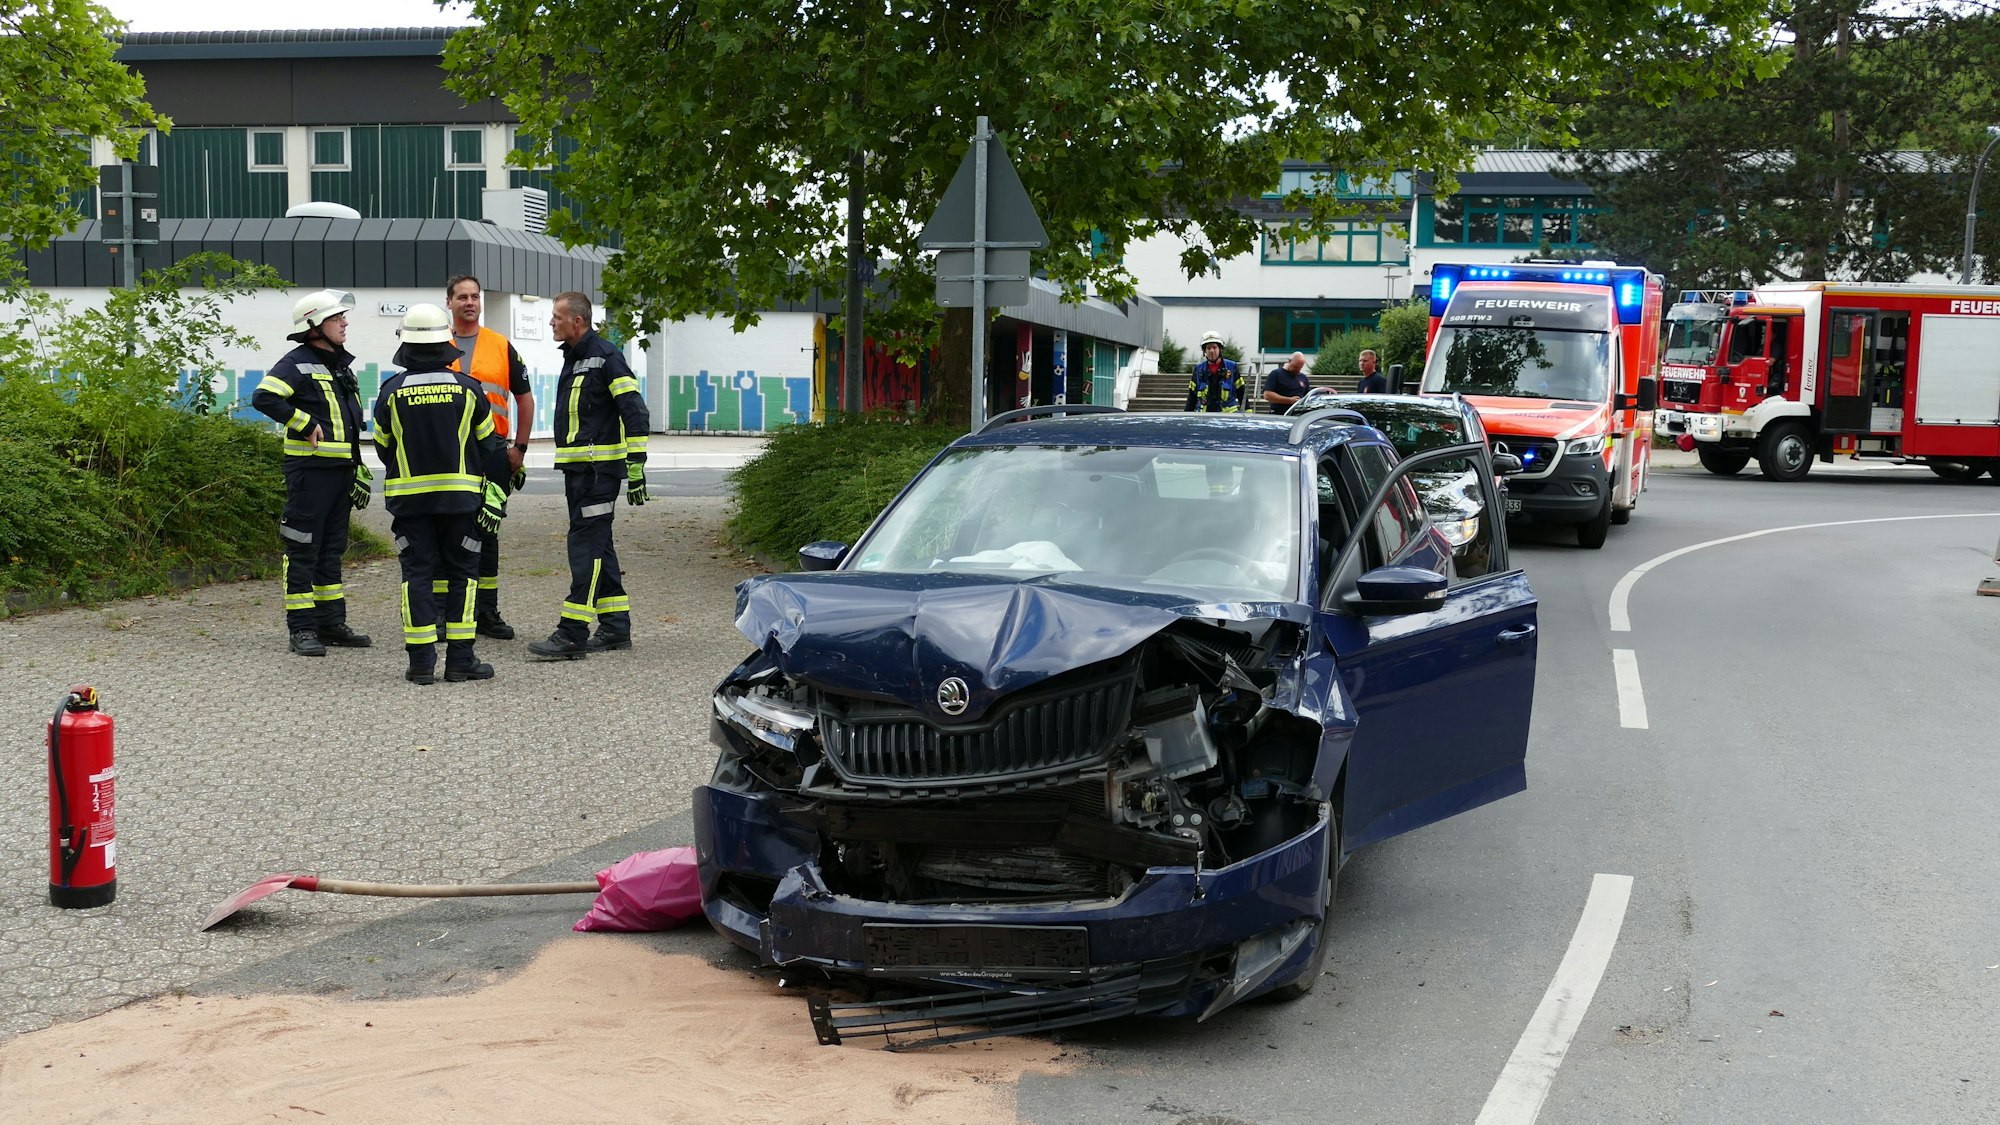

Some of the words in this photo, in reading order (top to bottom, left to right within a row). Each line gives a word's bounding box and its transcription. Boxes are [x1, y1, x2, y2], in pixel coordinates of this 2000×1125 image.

[1474, 299, 1581, 312] FEUERWEHR
[1950, 300, 2000, 314] FEUER
[1660, 366, 1707, 380] FEUERWEHR
[396, 384, 463, 398] FEUERWEHR
[407, 393, 453, 406] LOHMAR
[93, 784, 98, 793] 1
[92, 793, 100, 802] 2
[92, 802, 100, 812] 3
